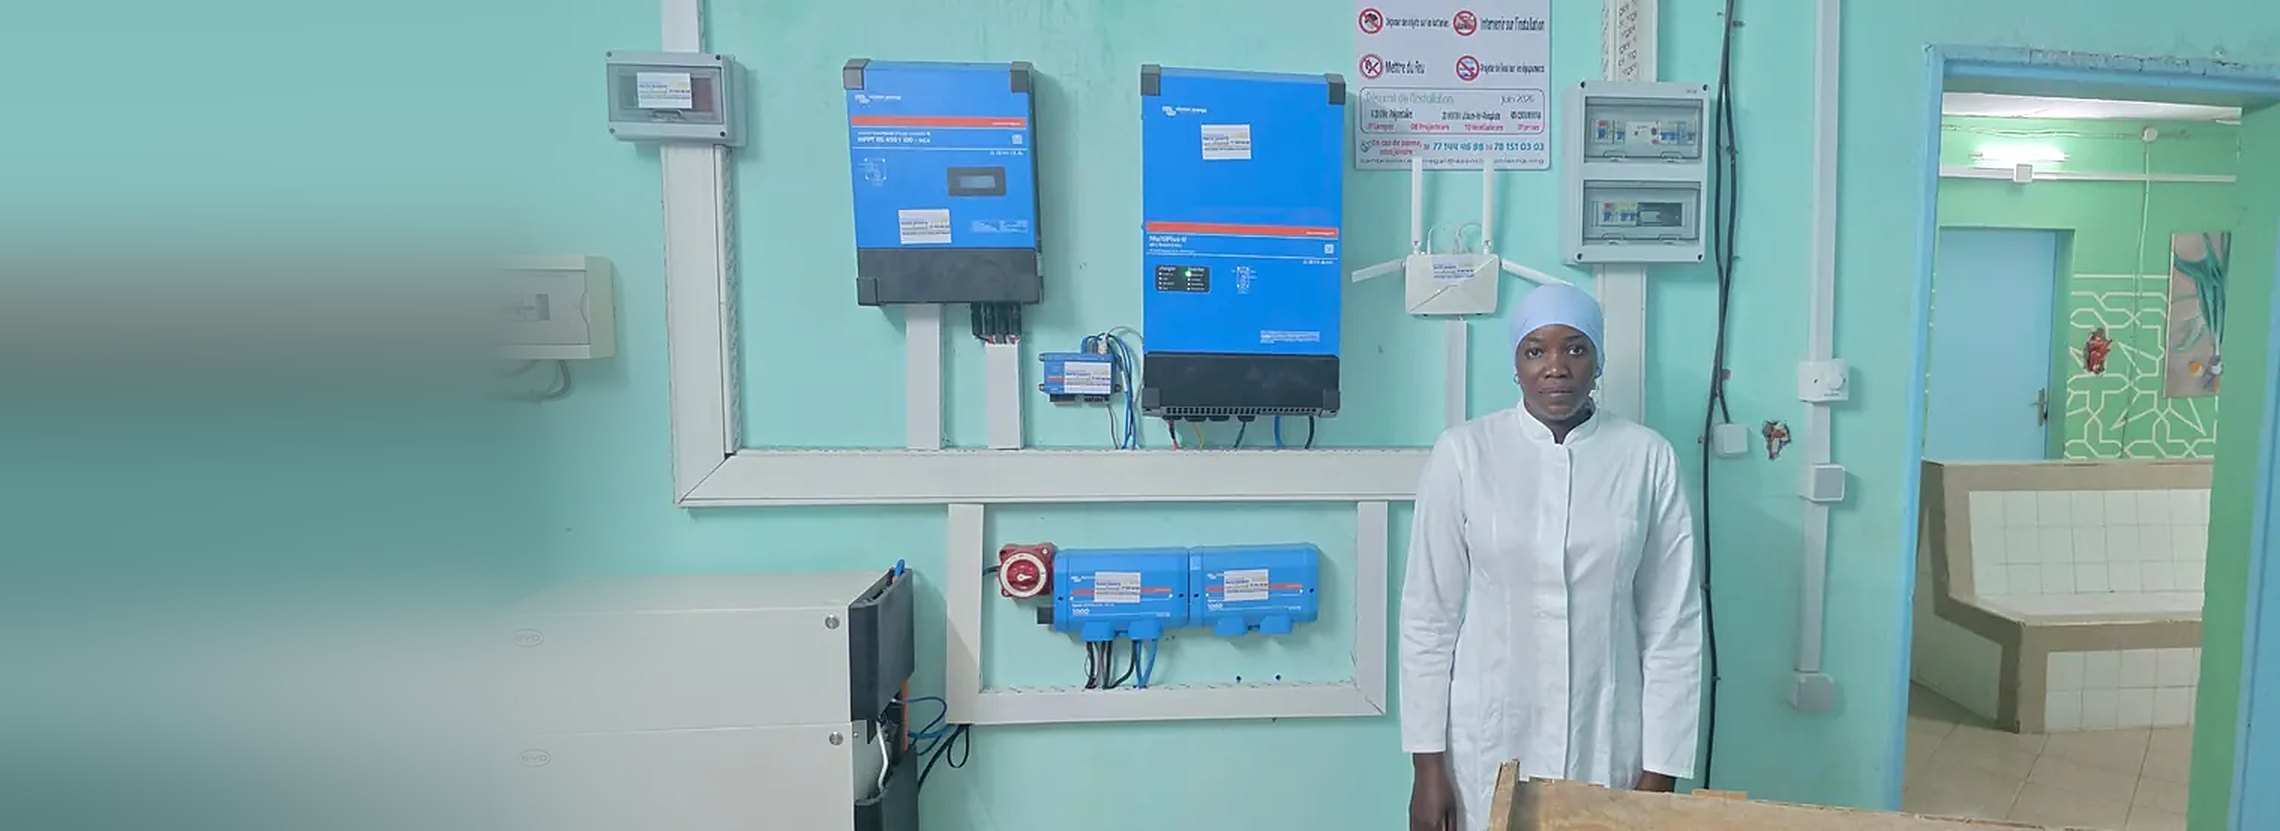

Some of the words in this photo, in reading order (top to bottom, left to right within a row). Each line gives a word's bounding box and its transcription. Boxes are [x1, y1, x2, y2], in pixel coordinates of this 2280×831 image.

[1433, 142, 1442, 151] 77
[1506, 142, 1519, 151] 151
[1520, 142, 1532, 151] 03
[1533, 142, 1545, 151] 03
